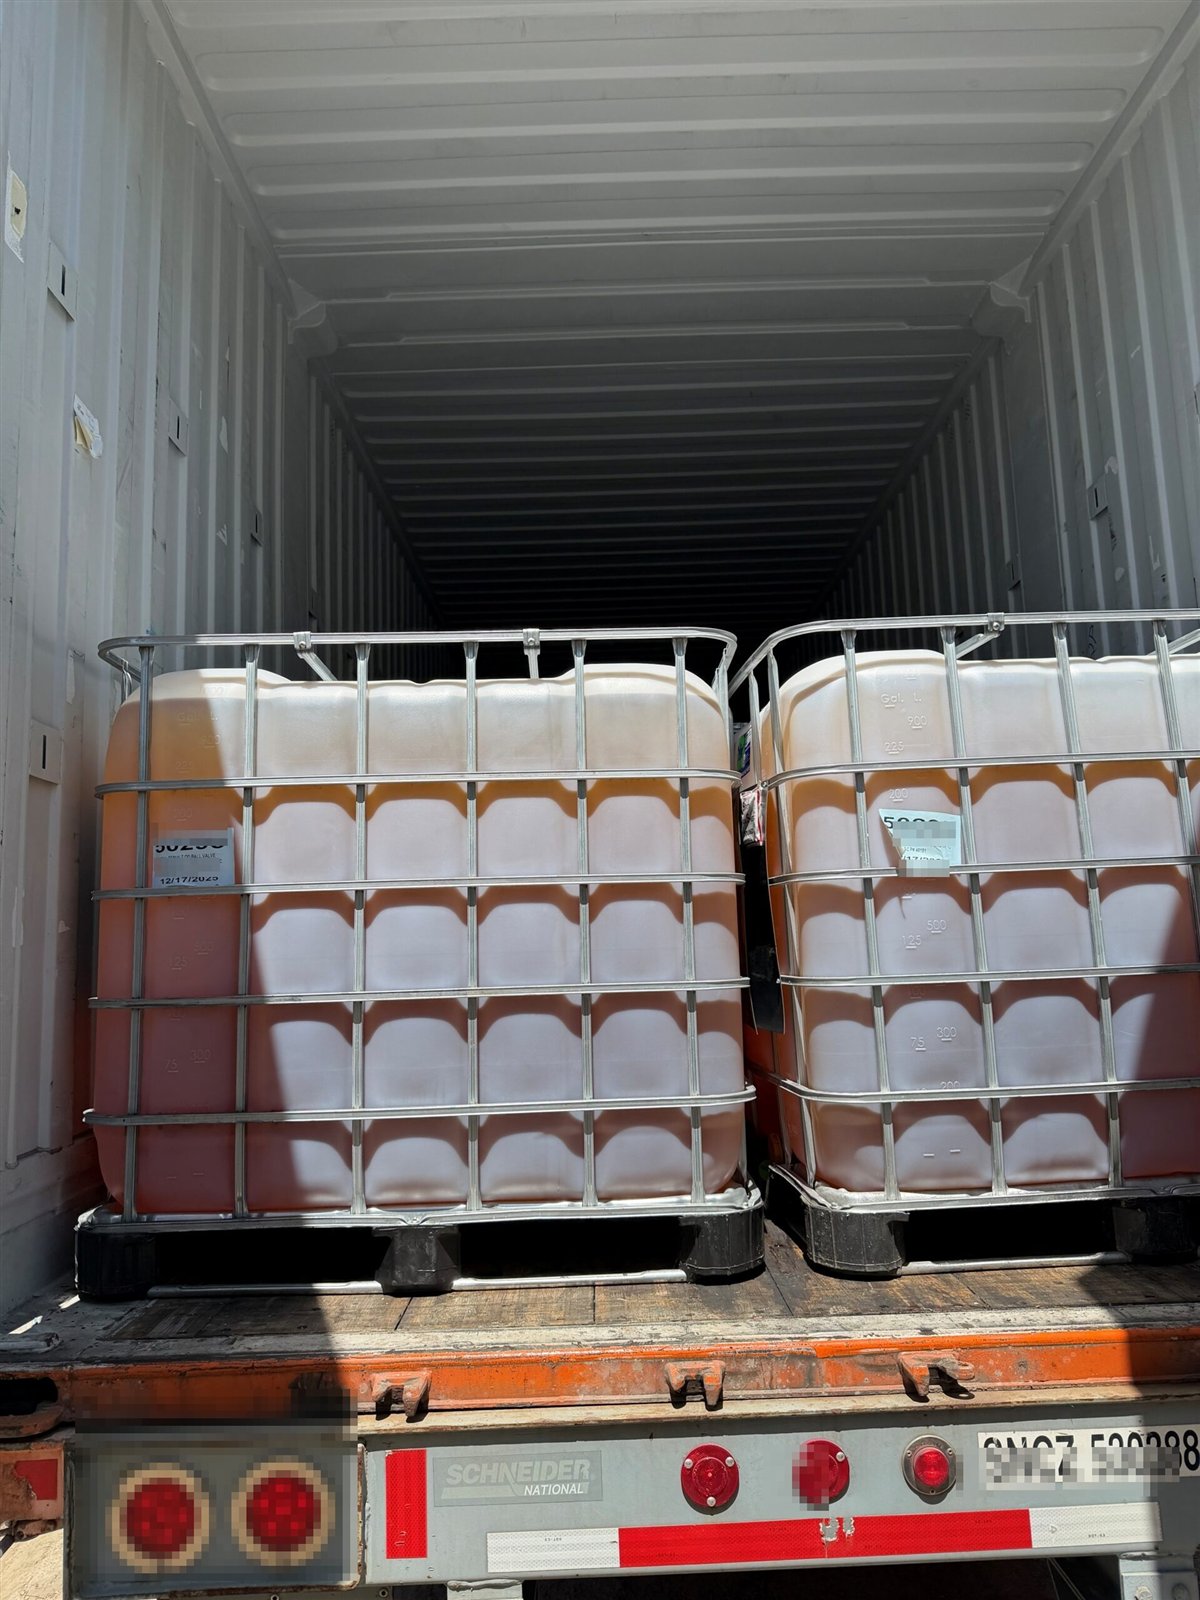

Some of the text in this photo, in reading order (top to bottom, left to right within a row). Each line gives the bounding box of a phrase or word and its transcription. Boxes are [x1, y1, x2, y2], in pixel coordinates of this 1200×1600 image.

[907, 715, 927, 726] 900
[927, 919, 947, 930] 500
[936, 1026, 957, 1037] 300
[910, 1037, 925, 1047] 75
[446, 1459, 591, 1486] SCHNEIDER
[524, 1482, 584, 1496] NATIONAL
